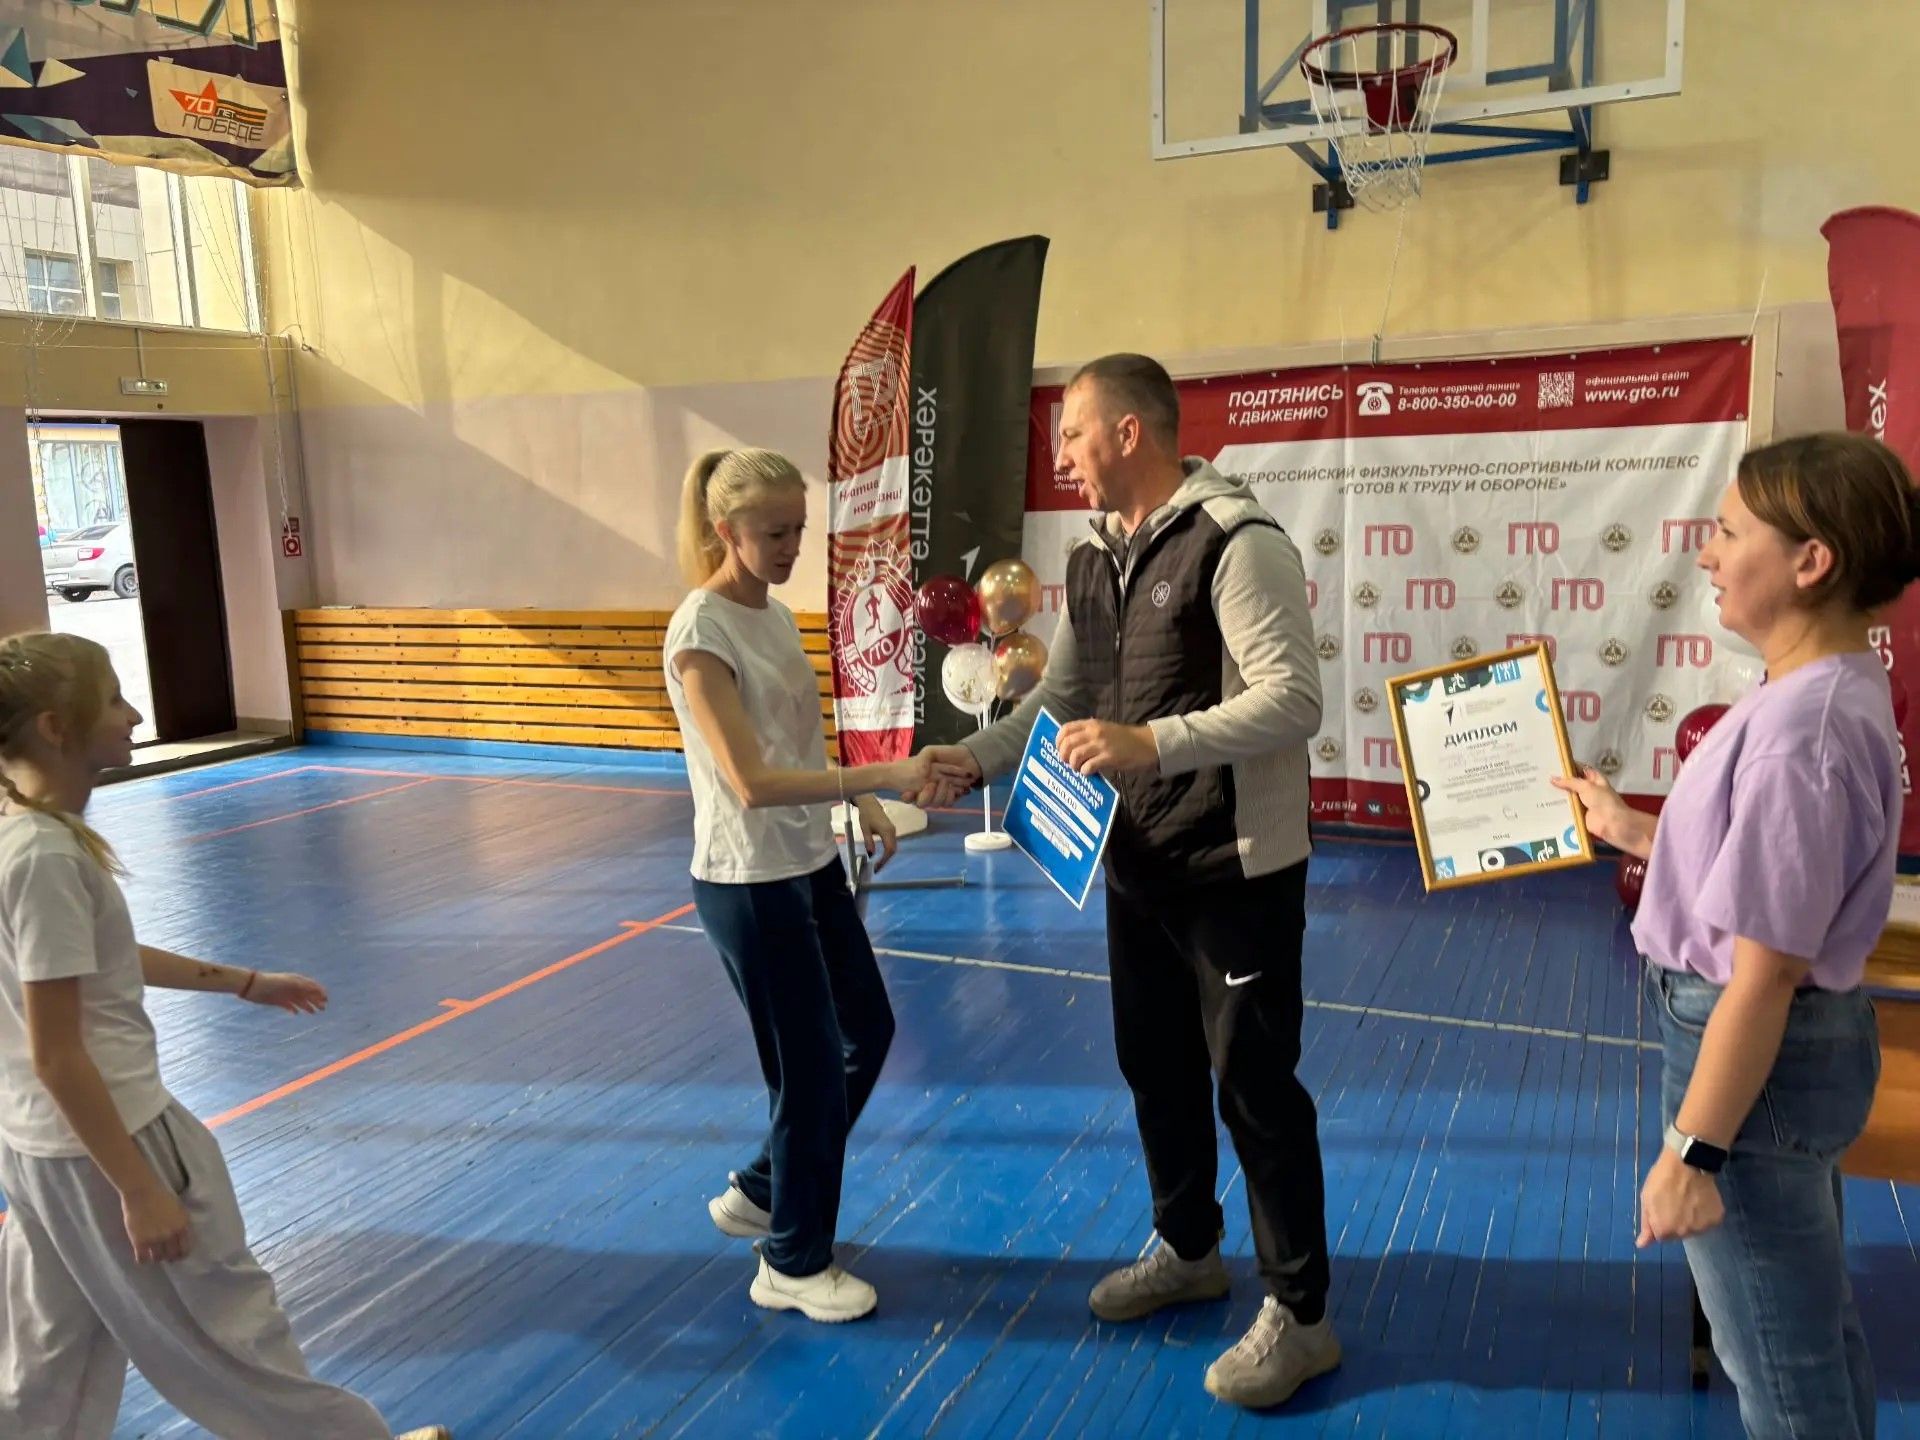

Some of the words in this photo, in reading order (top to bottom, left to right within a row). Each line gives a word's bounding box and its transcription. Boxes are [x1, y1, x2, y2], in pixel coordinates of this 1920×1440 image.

[184, 95, 215, 114] 70
[182, 112, 264, 143] ПОБЕДЕ
[1585, 371, 1659, 387] официальный
[1662, 370, 1690, 381] сайт
[1228, 384, 1344, 409] ПОДТЯНИСЬ
[1398, 392, 1517, 412] 8-800-350-00-00
[1585, 385, 1680, 404] www.gto.ru
[1229, 412, 1238, 425] К
[1240, 405, 1329, 427] ДВИЖЕНИЮ
[1359, 459, 1600, 478] ФИЗКУЛЬТУРНО-СПОРТИВНЫЙ
[1605, 455, 1700, 472] КОМПЛЕКС
[1399, 480, 1410, 493] К
[1413, 480, 1461, 496] ТРУДУ
[1465, 479, 1476, 492] И
[1480, 476, 1567, 492] ОБОРОНЕ»
[1364, 524, 1414, 556] ГТО
[1508, 522, 1559, 555] ГТО
[1662, 518, 1717, 553] ГТО
[1405, 578, 1456, 610] ГТО
[1551, 578, 1605, 610] ГТО
[1364, 632, 1412, 663] ГТО
[1656, 633, 1712, 667] ГТО
[1560, 690, 1601, 722] ТО
[1443, 720, 1518, 749] ДИПЛОМ
